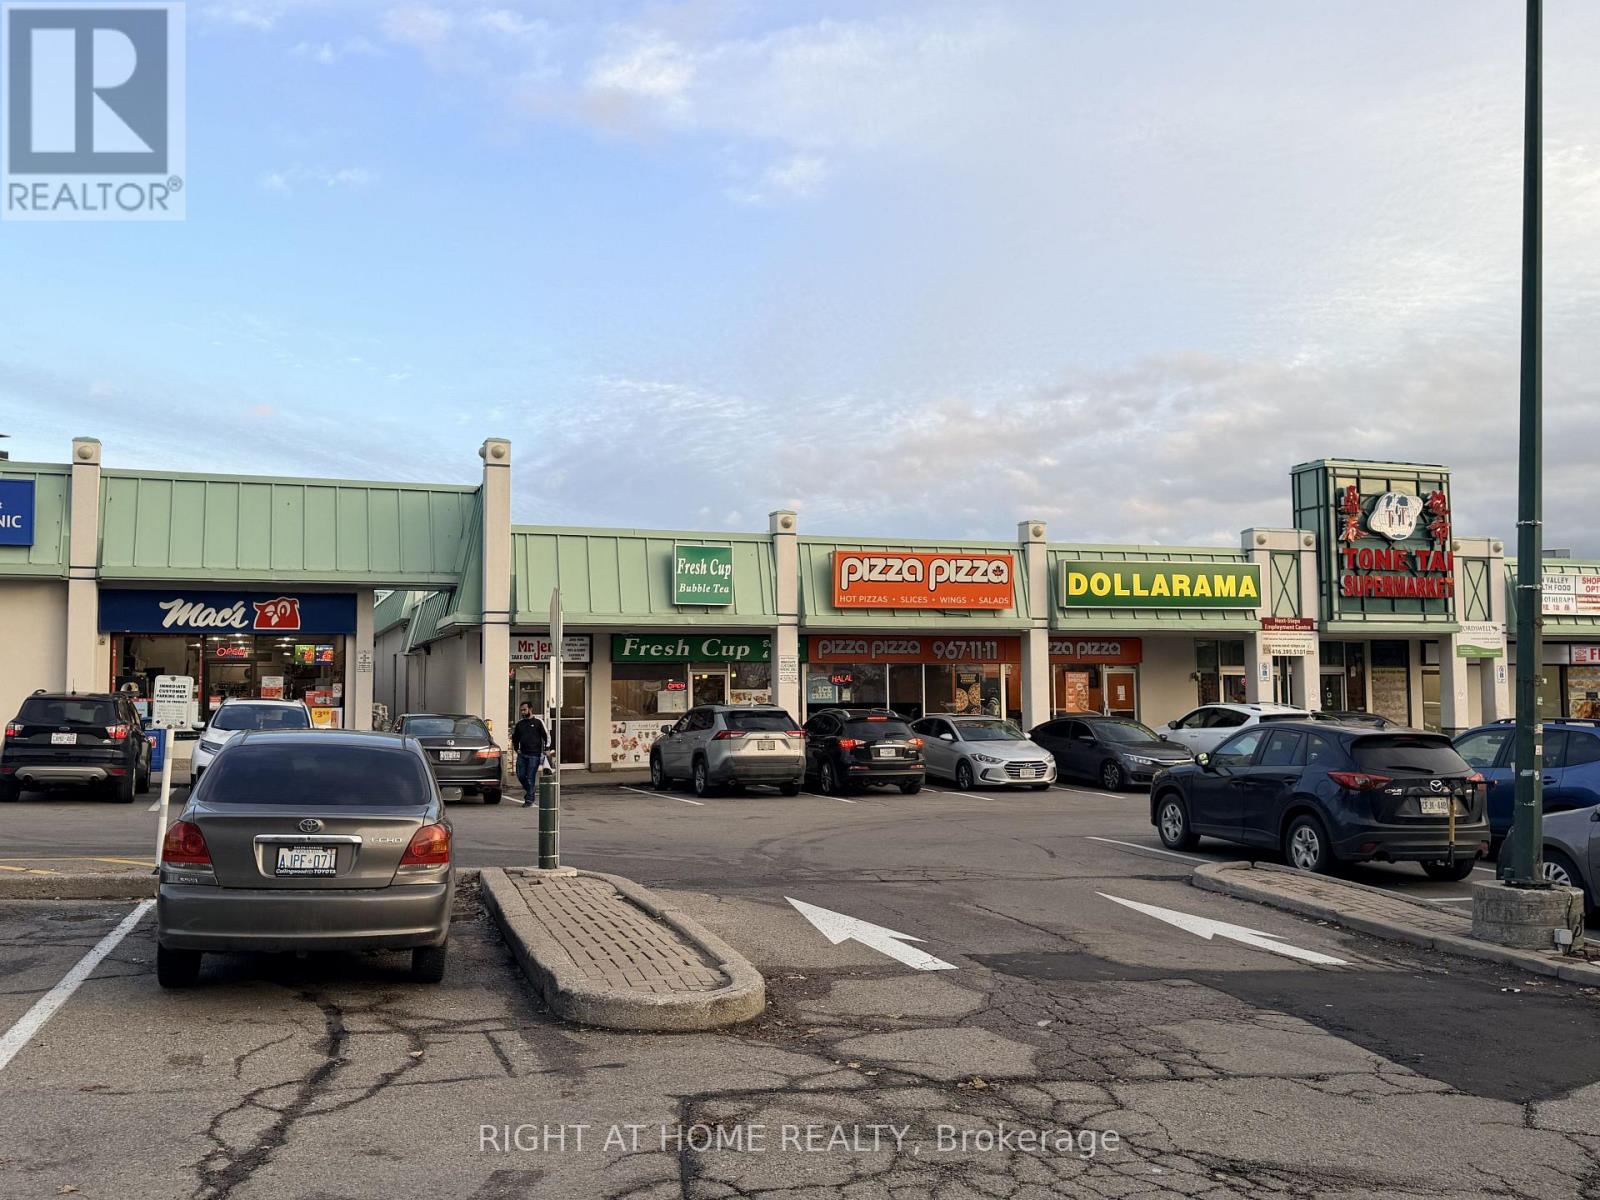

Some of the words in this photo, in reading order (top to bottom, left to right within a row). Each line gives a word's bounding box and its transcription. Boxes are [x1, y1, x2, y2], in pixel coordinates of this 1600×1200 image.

[677, 558, 707, 576] Fresh
[710, 558, 732, 579] Cup
[1342, 547, 1409, 571] TONE
[1415, 549, 1454, 572] TAI
[679, 583, 710, 593] Bubble
[712, 584, 730, 593] Tea
[1068, 572, 1258, 598] DOLLARAMA
[1341, 575, 1455, 598] SUPERMARKET
[839, 595, 857, 603] HOT
[859, 595, 888, 603] PIZZAS
[900, 596, 928, 604] SLICES
[939, 596, 967, 604] WINGS
[978, 596, 1009, 604] SALADS
[159, 598, 249, 629] Mac's
[533, 640, 553, 660] Jer
[621, 638, 690, 656] Fresh
[701, 638, 750, 660] Cup
[831, 674, 854, 683] HALAL
